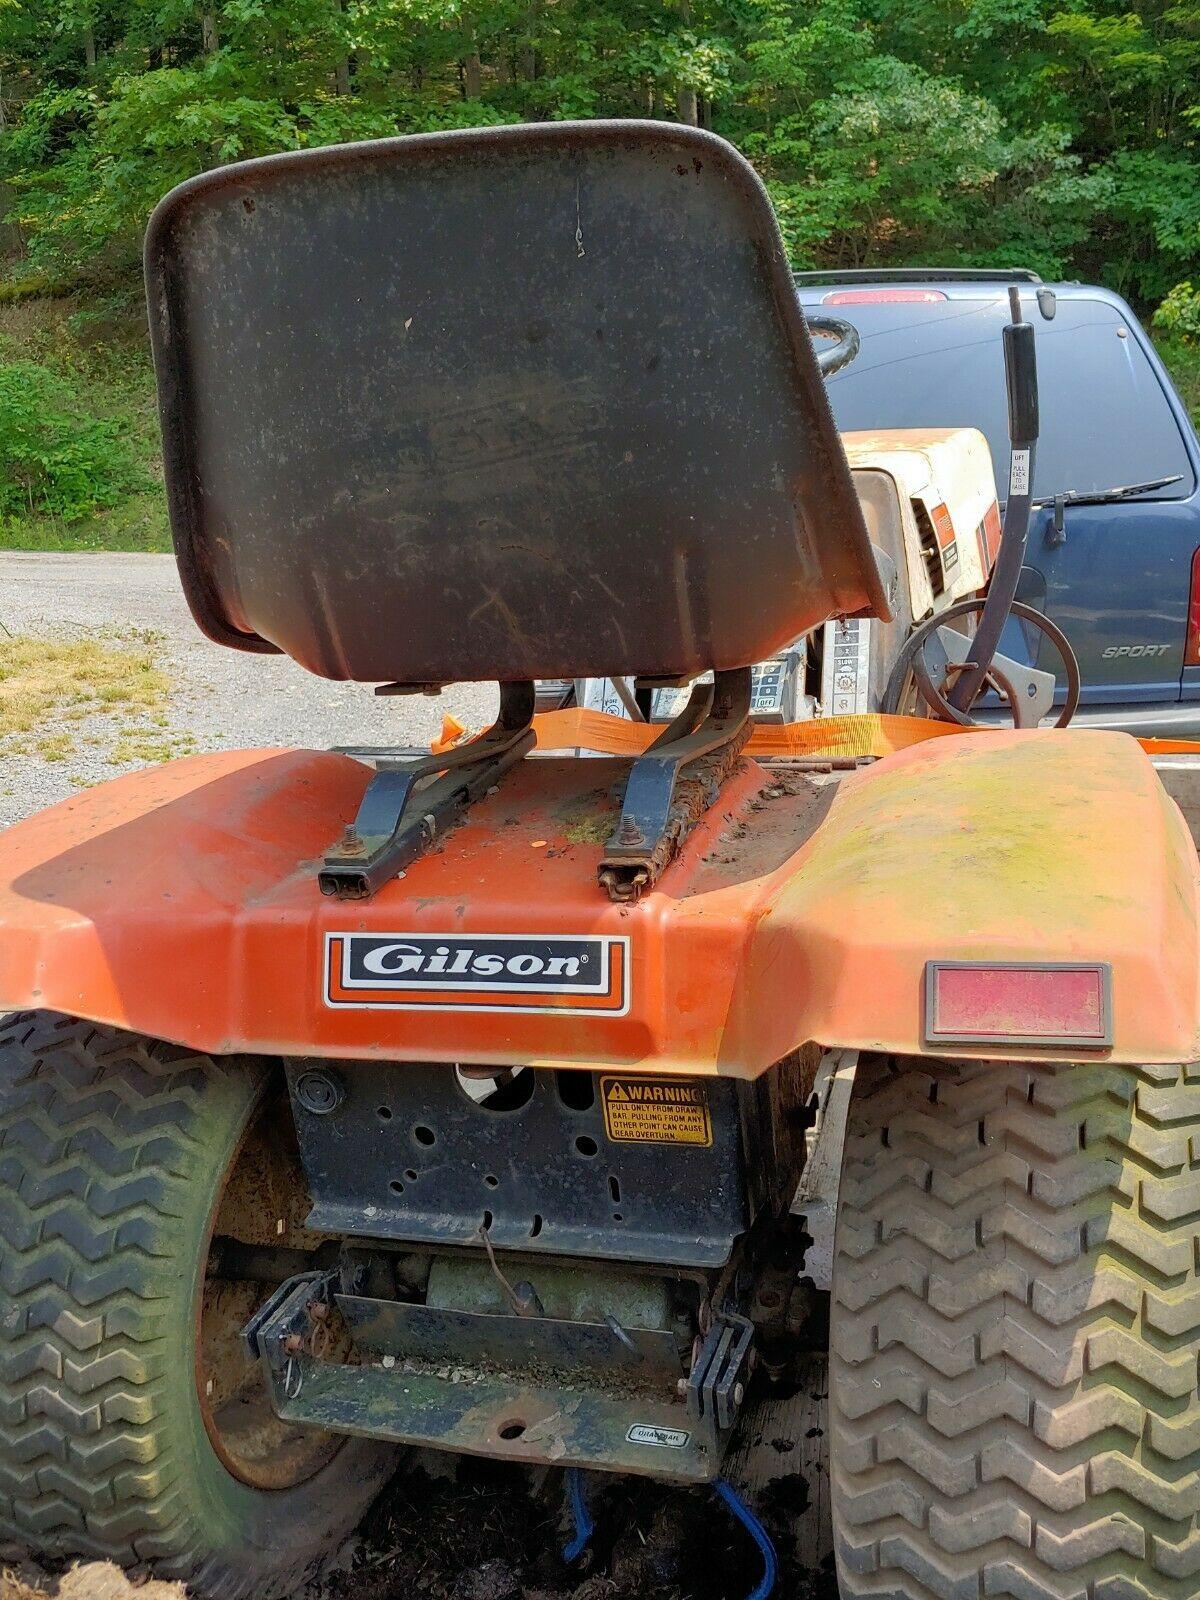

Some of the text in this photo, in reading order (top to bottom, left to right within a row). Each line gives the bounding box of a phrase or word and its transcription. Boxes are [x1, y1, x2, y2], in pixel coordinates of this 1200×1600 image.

[1101, 644, 1172, 659] SPORT
[363, 943, 581, 977] Gilson
[611, 1103, 630, 1111] PULL
[631, 1104, 650, 1112] ONLY
[652, 1104, 673, 1113] FROM
[631, 1113, 662, 1122] PULLING
[664, 1114, 686, 1123] FROM
[687, 1115, 702, 1123] ANY
[613, 1121, 703, 1132] OTHER POINT CAN CAUSE
[615, 1129, 635, 1138] REAR
